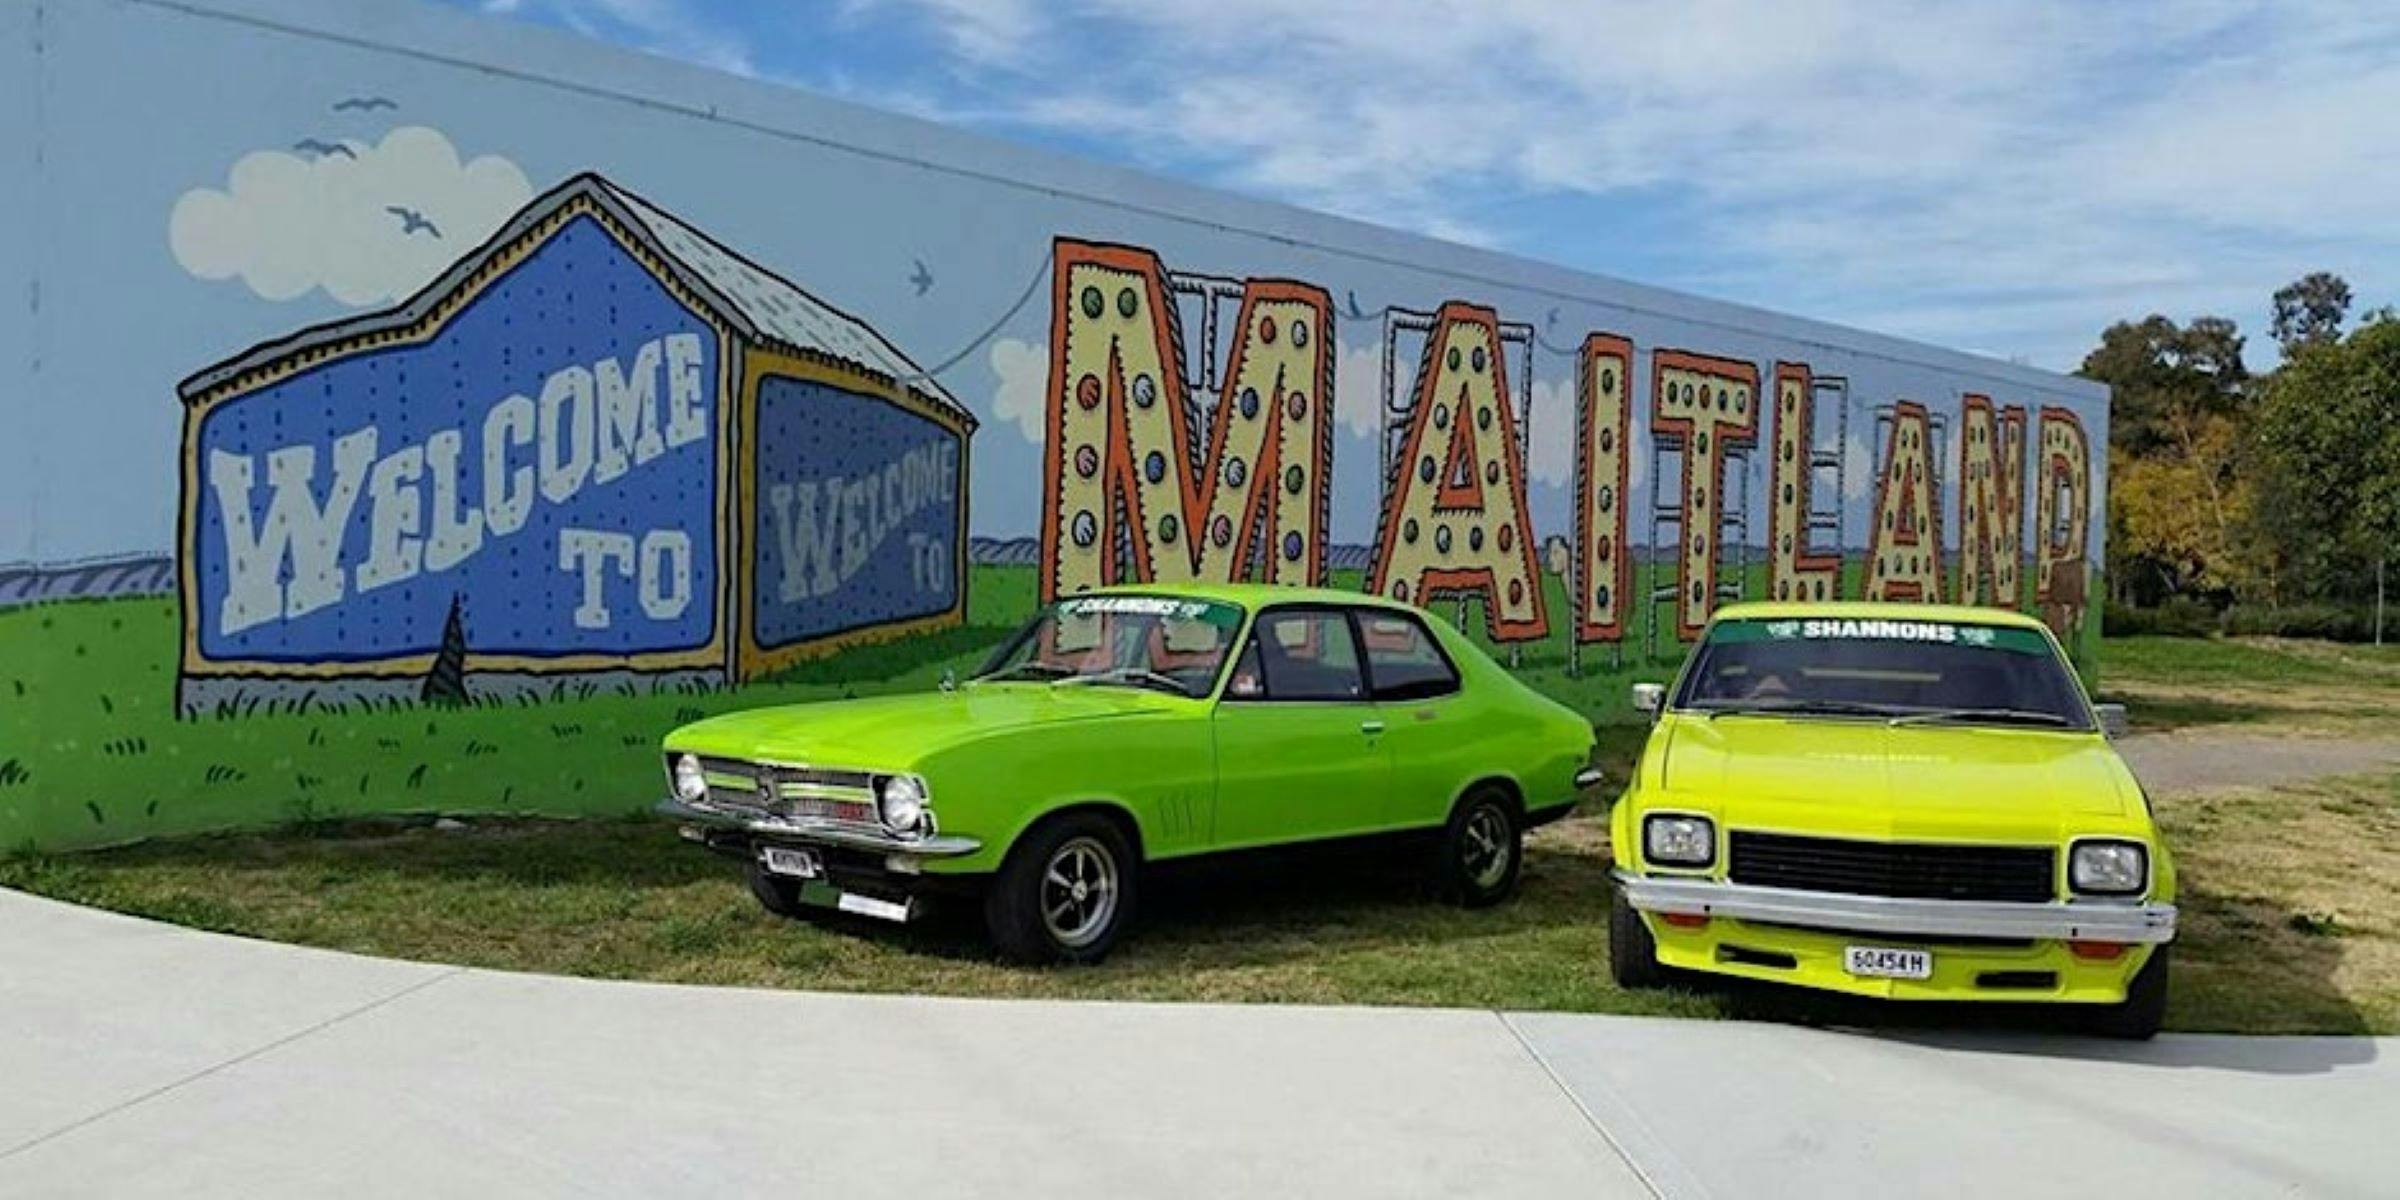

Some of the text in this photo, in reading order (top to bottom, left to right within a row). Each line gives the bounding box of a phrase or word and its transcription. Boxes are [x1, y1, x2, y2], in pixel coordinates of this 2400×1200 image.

[209, 332, 708, 636] WELCOME
[1039, 237, 2090, 644] MAITLAND
[558, 529, 693, 629] TO
[770, 439, 956, 603] WELCOME
[907, 531, 946, 593] TO
[1803, 620, 1957, 643] SHANNONS
